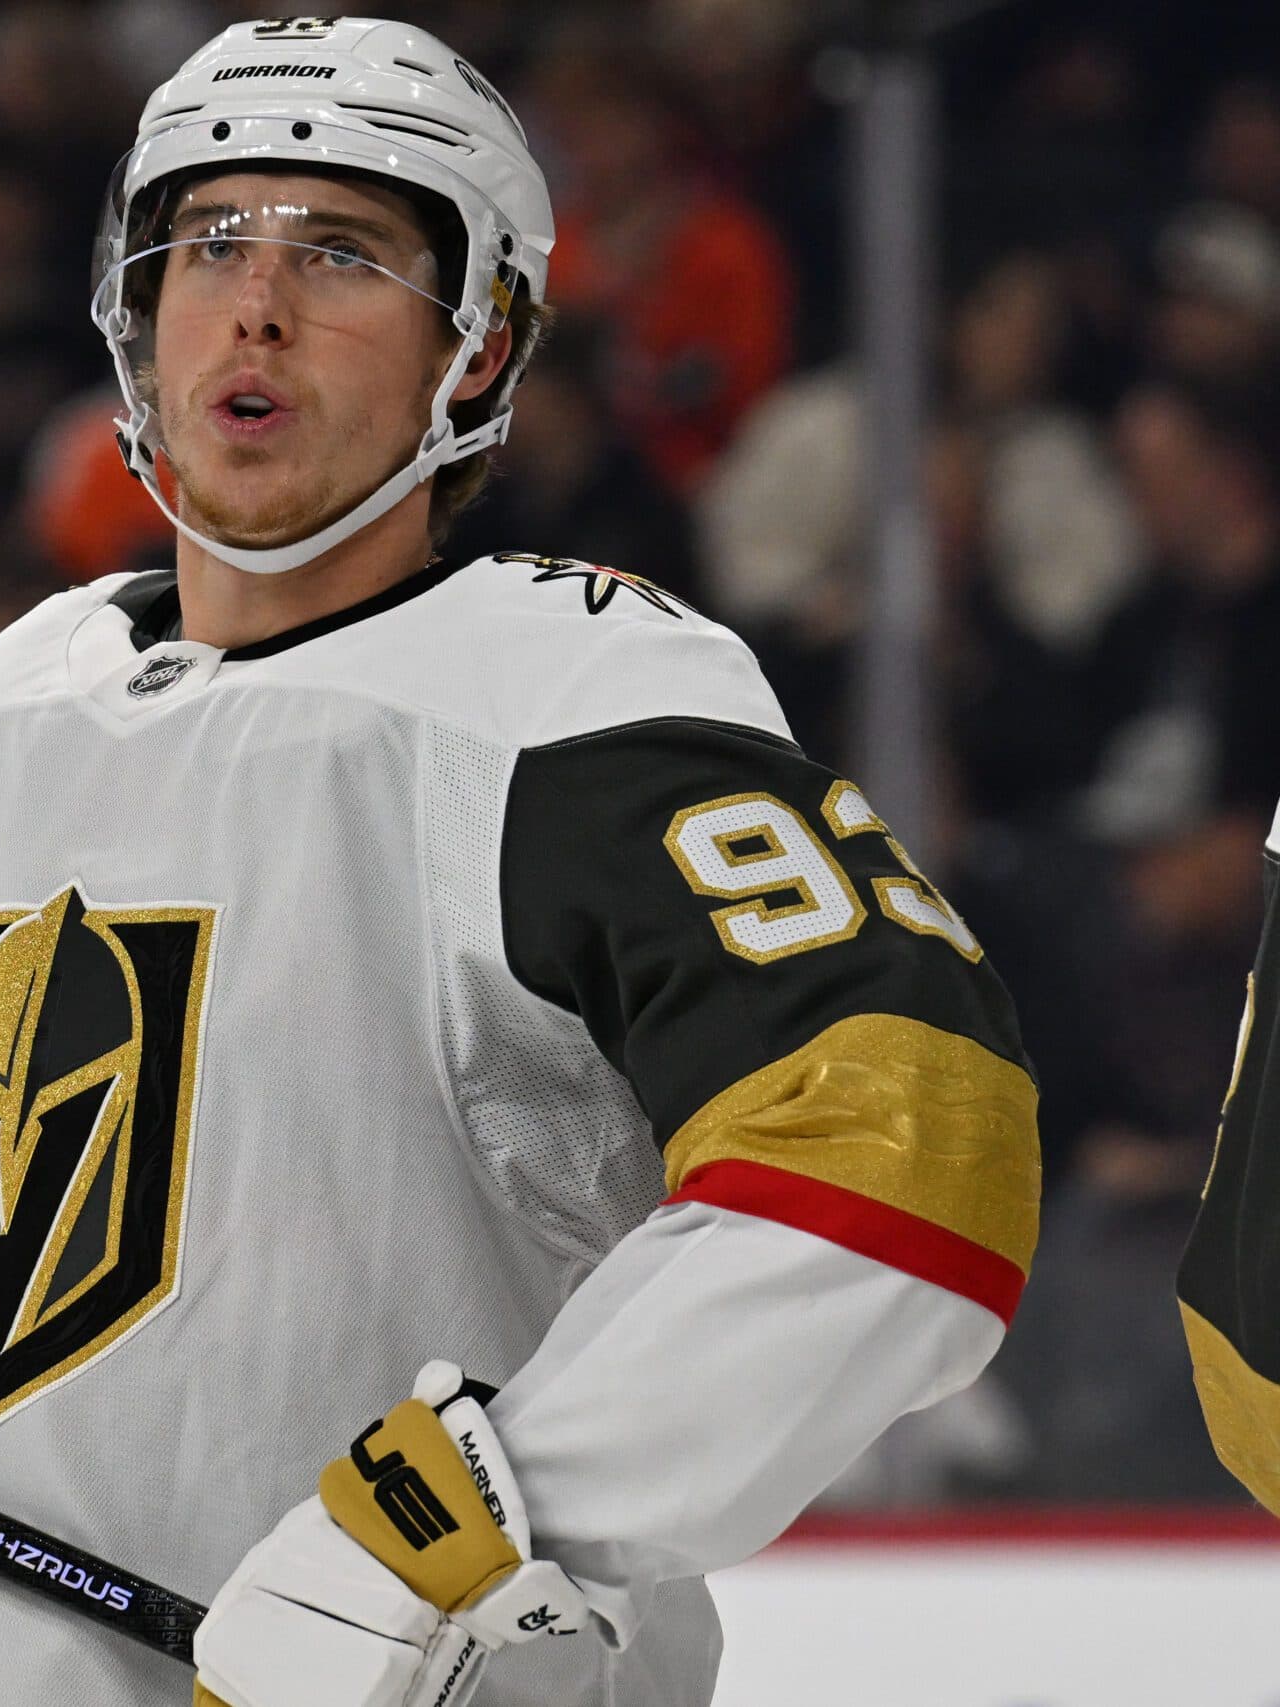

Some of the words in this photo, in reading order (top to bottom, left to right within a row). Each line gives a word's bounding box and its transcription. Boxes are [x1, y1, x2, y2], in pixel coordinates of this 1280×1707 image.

[212, 65, 337, 82] WARRIOR
[663, 779, 984, 965] 93
[458, 1430, 507, 1528] MARNER
